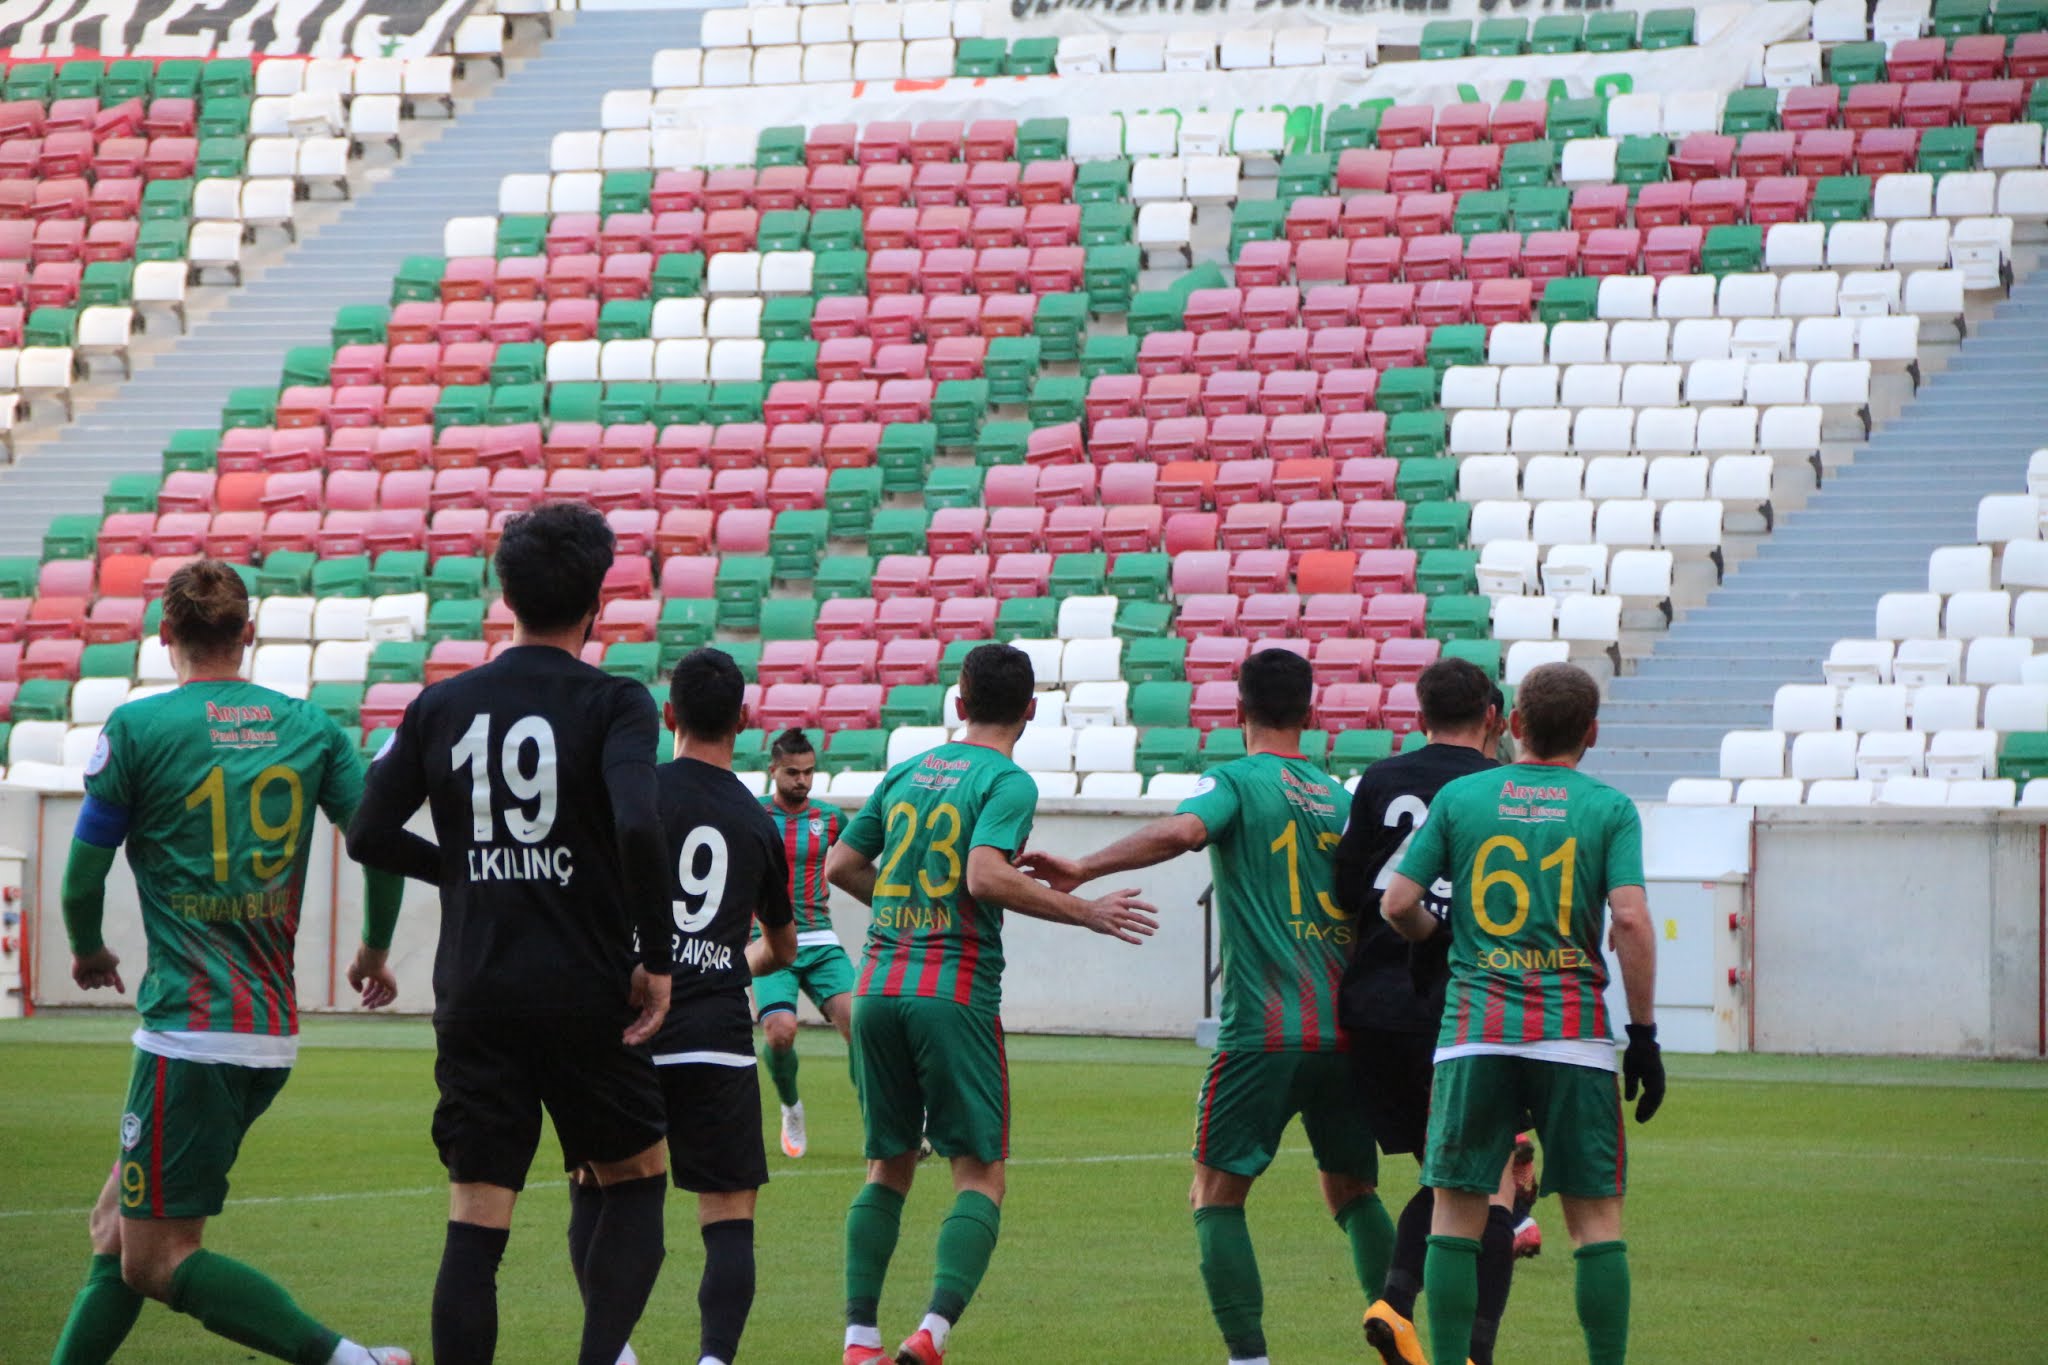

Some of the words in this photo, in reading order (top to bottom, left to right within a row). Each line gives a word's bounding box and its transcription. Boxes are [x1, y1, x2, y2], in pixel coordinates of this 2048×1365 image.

[185, 765, 303, 882] 19
[452, 714, 558, 844] 19
[673, 825, 729, 933] 9
[874, 802, 961, 897] 23
[1471, 834, 1577, 936] 61
[679, 937, 732, 974] AVŞAR
[1477, 947, 1593, 969] SÖNMEZ
[123, 1161, 145, 1208] 9
